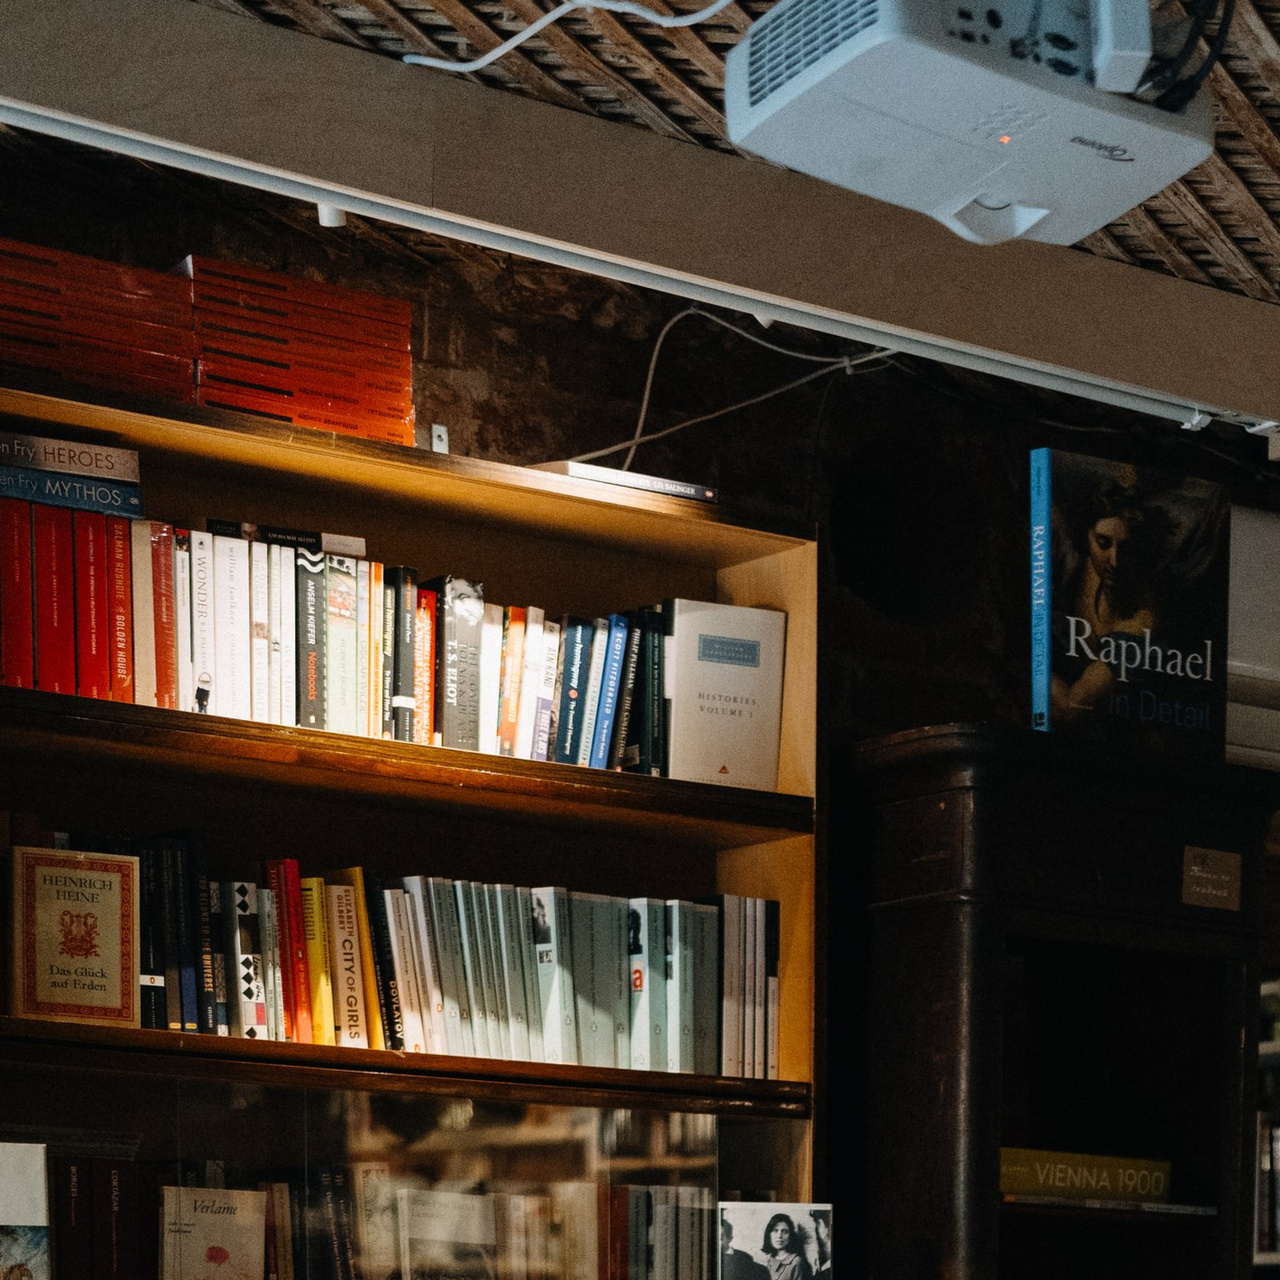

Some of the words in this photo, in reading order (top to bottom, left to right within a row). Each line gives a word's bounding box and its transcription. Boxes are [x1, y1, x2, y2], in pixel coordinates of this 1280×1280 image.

[14, 440, 35, 461] Fry
[43, 446, 115, 470] HEROES
[18, 474, 38, 493] Fry
[45, 479, 121, 506] MYTHOS
[114, 524, 124, 560] SALMAN
[115, 562, 125, 600] RUSHDIE
[1033, 525, 1045, 610] RAPHAEL
[197, 556, 208, 618] WONDER
[307, 580, 315, 614] ANSELM
[116, 615, 126, 649] GOLDEN
[308, 615, 316, 645] KIEFER
[384, 609, 394, 658] hemingway
[447, 640, 458, 650] T.
[612, 632, 624, 660] SCOTT
[632, 628, 642, 653] PHILIP
[117, 649, 127, 680] HOUSE
[447, 652, 458, 664] S.
[547, 647, 555, 662] AYN
[1065, 616, 1213, 682] Raphael
[308, 652, 317, 700] Notebooks
[544, 663, 554, 687] RAND
[569, 643, 584, 689] hemingway
[627, 654, 639, 689] PULLMAN
[446, 667, 458, 707] ELIOT
[605, 662, 619, 714] FITZGERALD
[698, 692, 757, 706] HISTORIES
[700, 705, 743, 718] VOLUME
[538, 732, 548, 755] PLAYS
[42, 875, 114, 891] HEINRICH
[56, 889, 101, 904] HEINE
[336, 894, 346, 931] GILBERT
[344, 888, 354, 937] ELIZABETH
[201, 937, 211, 952] THE
[342, 938, 356, 979] CITY
[50, 965, 72, 976] Das
[74, 966, 108, 979] Glück
[50, 979, 69, 989] auf
[73, 980, 107, 992] Erden
[202, 953, 214, 993] UNIVERSE
[346, 978, 355, 993] OF
[346, 995, 360, 1040] GIRLS
[389, 980, 405, 1039] DOVLATOV
[1036, 1162, 1110, 1190] VIENNA
[1118, 1168, 1165, 1195] 1900
[193, 1199, 238, 1215] Verlaine
